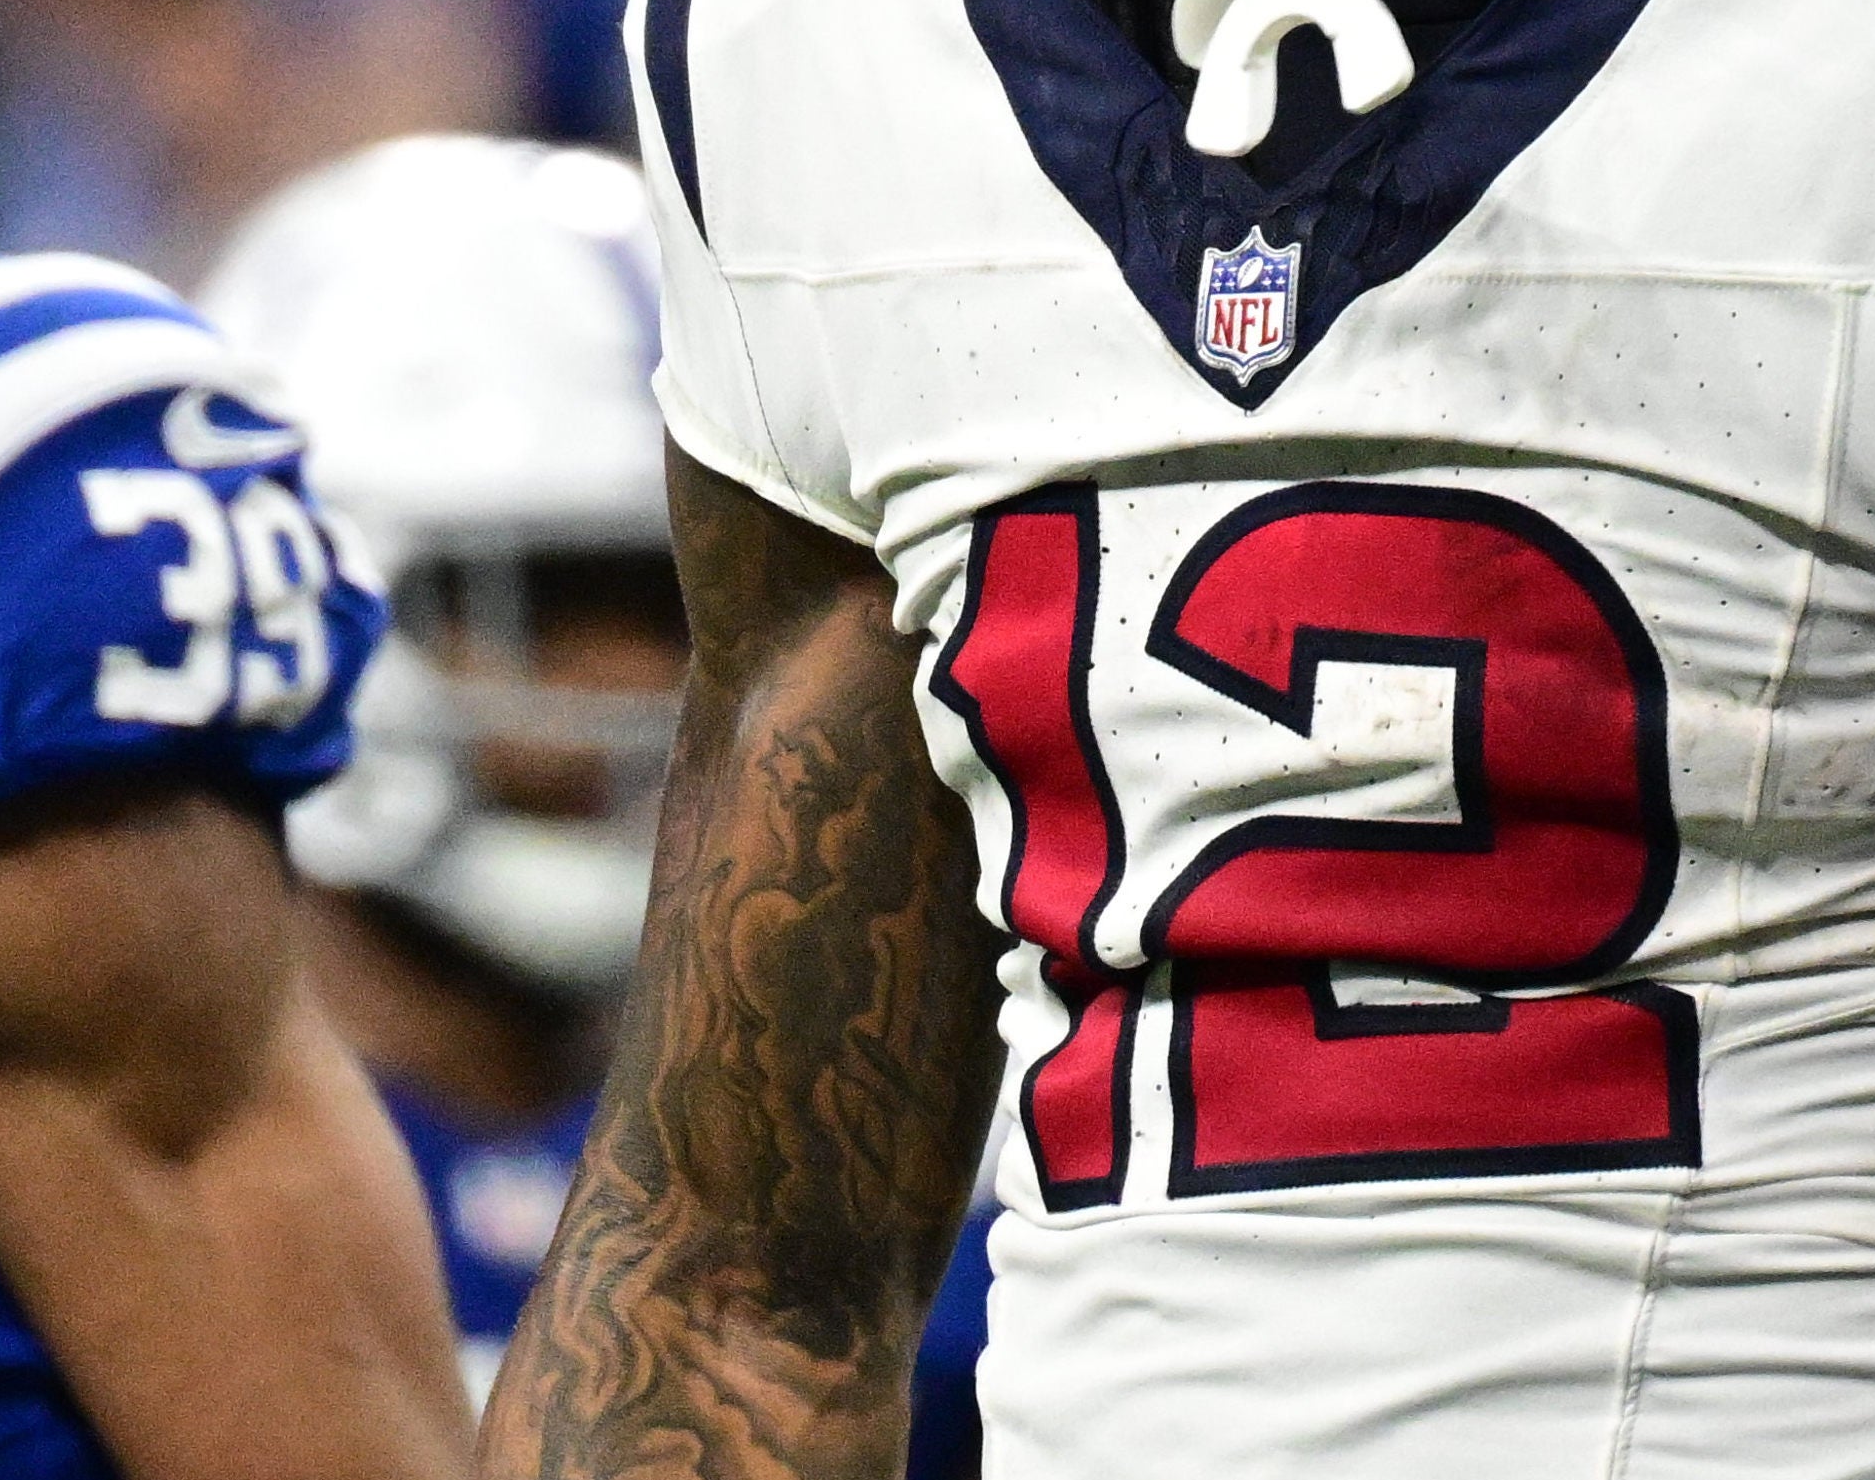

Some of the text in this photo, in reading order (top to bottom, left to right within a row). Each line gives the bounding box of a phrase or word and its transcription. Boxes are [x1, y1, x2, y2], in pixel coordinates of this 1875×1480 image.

[1211, 296, 1279, 354] NFL
[79, 467, 330, 726] 39
[929, 479, 1702, 1213] 12
